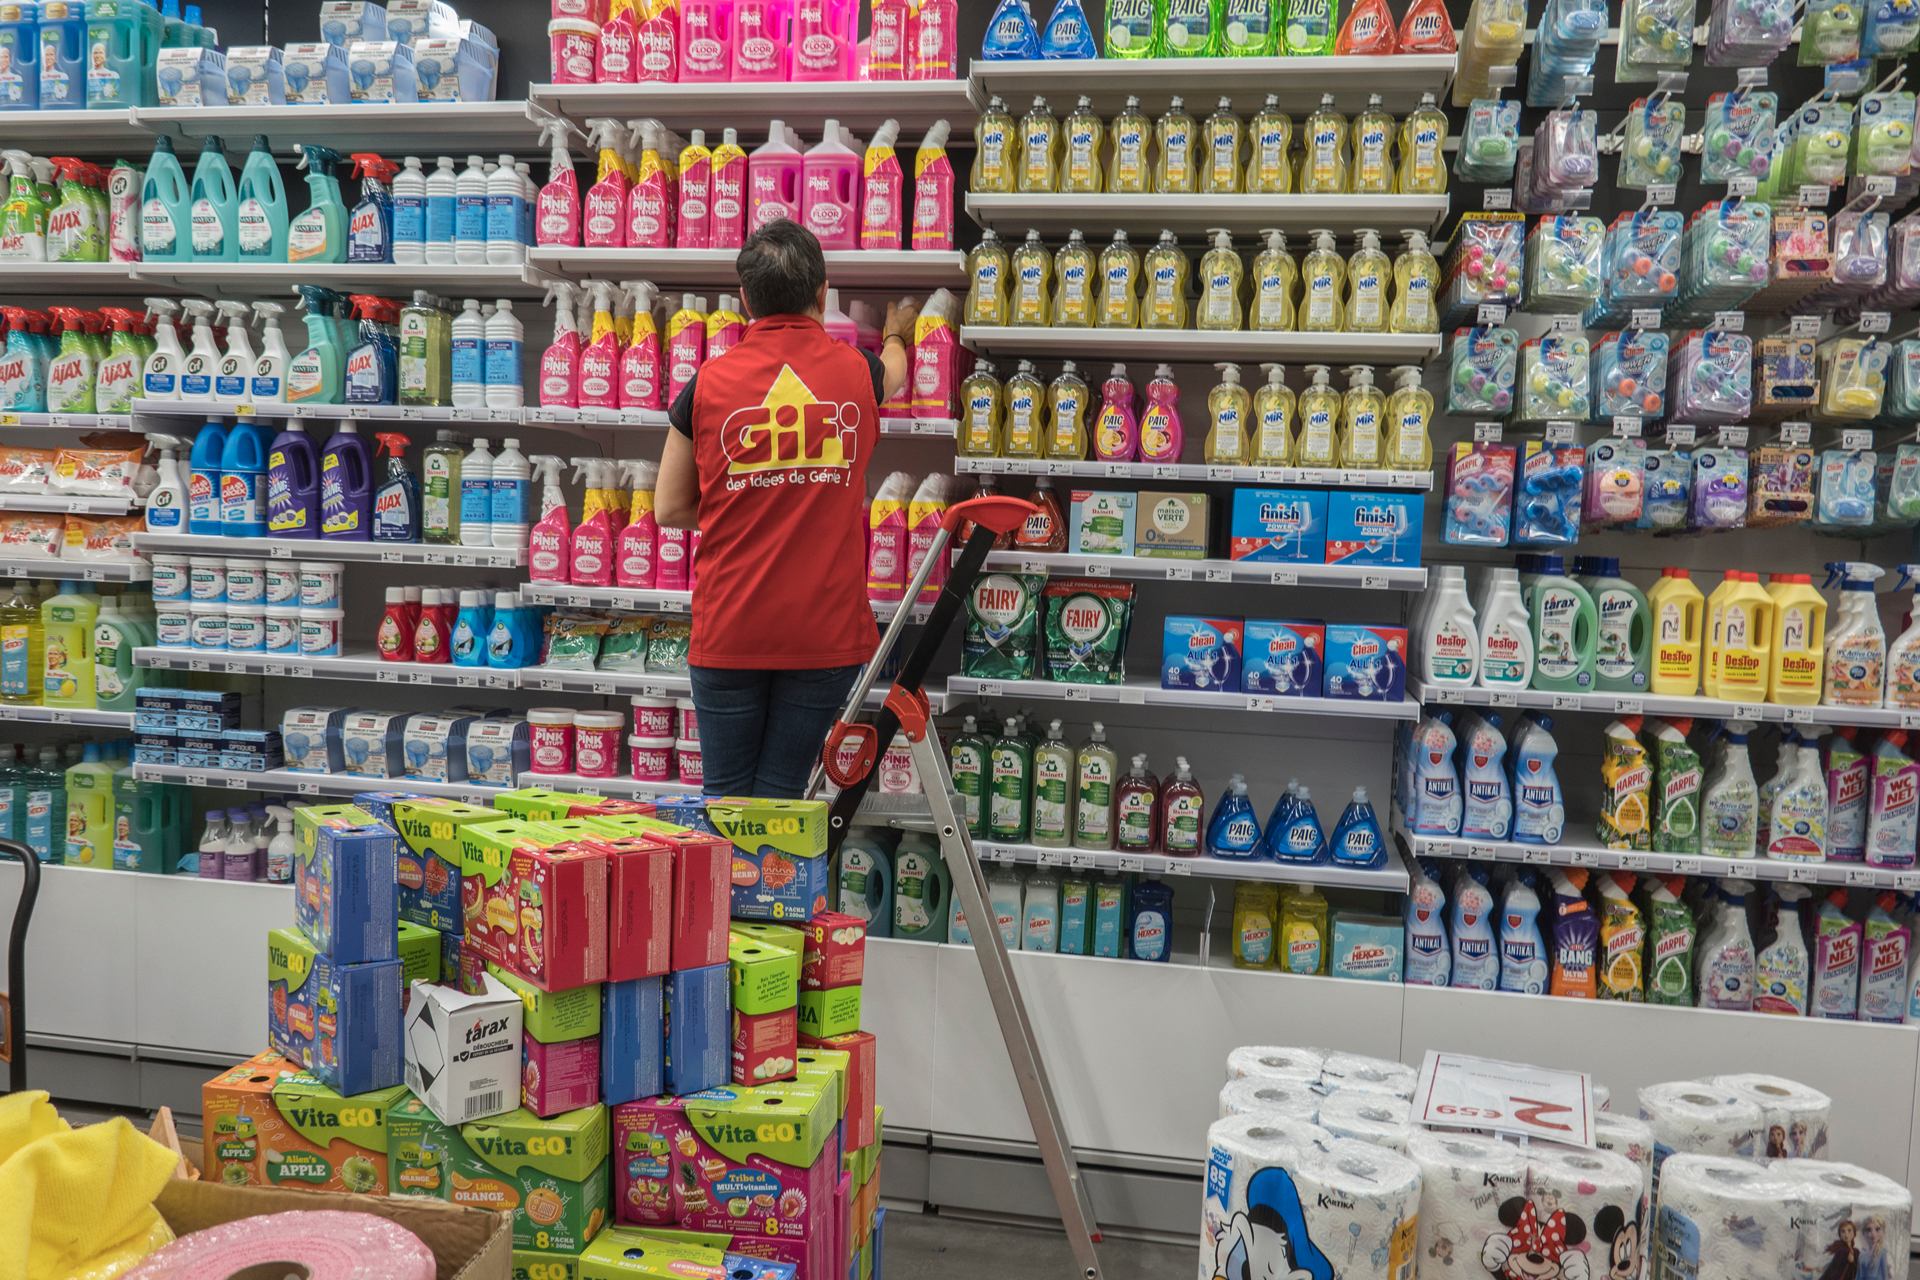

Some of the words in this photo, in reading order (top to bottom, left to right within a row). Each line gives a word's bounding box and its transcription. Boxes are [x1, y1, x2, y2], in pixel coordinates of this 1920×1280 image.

[998, 20, 1023, 35] PAIC
[1055, 21, 1080, 35] PAIC
[1354, 15, 1379, 31] PAIC
[1414, 15, 1442, 30] PAIC
[805, 42, 831, 50] FLOOR
[715, 182, 740, 193] PINK
[541, 200, 570, 210] PINK
[812, 210, 839, 218] FLOOR
[50, 211, 81, 232] AJAX
[351, 213, 374, 233] AJAX
[673, 347, 697, 358] PINK
[152, 358, 167, 373] Cif
[187, 358, 204, 374] Cif
[223, 358, 238, 374] Cif
[257, 361, 272, 377] Cif
[348, 354, 371, 375] AJAX
[544, 361, 569, 371] PINK
[583, 362, 610, 373] PINK
[626, 364, 653, 373] PINK
[52, 360, 83, 384] AJAX
[101, 360, 133, 384] AJAX
[1103, 415, 1124, 427] PAIC
[1148, 415, 1168, 427] PAIC
[1456, 458, 1480, 474] HARPIC
[1526, 456, 1548, 471] HARPIC
[726, 477, 746, 491] des
[750, 471, 785, 489] idées
[789, 470, 805, 484] de
[809, 468, 841, 484] Génie
[845, 470, 851, 487] !
[156, 493, 173, 507] Cif
[376, 493, 401, 513] AJAX
[1158, 514, 1184, 522] VERTE
[1260, 504, 1300, 520] finish
[1356, 507, 1395, 523] finish
[1026, 516, 1050, 530] PAIC
[1361, 526, 1388, 534] POWER
[661, 527, 683, 536] PINK
[533, 536, 559, 547] PINK
[576, 540, 603, 550] PINK
[624, 541, 651, 551] PINK
[873, 535, 896, 546] PINK
[911, 536, 933, 546] PINK
[979, 588, 1020, 611] FAIRY
[1543, 596, 1576, 612] tarax
[1601, 599, 1633, 613] tarax
[1066, 608, 1101, 628] FAIRY
[1190, 635, 1215, 647] Clean
[1269, 640, 1295, 653] Clean
[1436, 634, 1466, 649] DesTop
[1487, 636, 1518, 651] DesTop
[1352, 643, 1378, 656] Clean
[1660, 650, 1692, 664] DesTop
[1726, 655, 1759, 669] DesTop
[1783, 657, 1816, 670] DesTop
[1248, 672, 1260, 680] 40
[1330, 675, 1342, 684] 40
[641, 715, 669, 726] PINK
[535, 732, 564, 742] PINK
[577, 734, 603, 746] PINK
[638, 757, 666, 767] PINK
[884, 755, 910, 766] PINK
[995, 767, 1020, 776] Rainett
[1040, 770, 1064, 780] Rainett
[1083, 773, 1108, 783] Rainett
[1843, 769, 1863, 784] WC
[1427, 781, 1452, 792] ANTIKAL
[1616, 772, 1646, 793] HARPIC
[1667, 775, 1696, 796] HARPIC
[1890, 776, 1911, 791] WC
[1472, 783, 1499, 797] ANTIKAL
[1525, 789, 1552, 801] ANTIKAL
[1839, 782, 1864, 798] NET
[1886, 787, 1913, 805] NET
[723, 817, 805, 836] VitaGO!
[1228, 822, 1254, 837] PAIC
[1290, 828, 1317, 842] PAIC
[1348, 832, 1374, 847] PAIC
[773, 902, 784, 919] 8
[431, 910, 438, 928] 8
[816, 927, 824, 943] 8
[1137, 928, 1162, 939] HEROES
[1244, 930, 1269, 943] HEROES
[1292, 942, 1318, 953] HEROES
[1414, 936, 1441, 949] ANTIKAL
[1461, 940, 1488, 954] ANTIKAL
[1609, 931, 1637, 951] HARPIC
[1657, 935, 1688, 957] HARPIC
[1832, 937, 1853, 953] WC
[1352, 949, 1384, 961] HEROES
[1507, 944, 1533, 957] ANTIKAL
[1879, 942, 1900, 956] WC
[1560, 949, 1592, 966] BANG
[1829, 949, 1855, 965] NET
[1875, 951, 1902, 967] NET
[1563, 970, 1588, 980] ULTRA
[466, 1017, 509, 1044] tarax
[290, 1108, 383, 1128] VitaGO!
[706, 1123, 802, 1144] VitaGO!
[222, 1149, 250, 1157] APPLE
[476, 1136, 573, 1157] VitaGO!
[286, 1155, 317, 1163] Alien's
[279, 1165, 326, 1177] APPLE
[729, 1174, 754, 1182] Tribe
[756, 1174, 766, 1182] of
[1210, 1165, 1226, 1189] 85
[476, 1183, 498, 1191] Little
[716, 1183, 778, 1192] MULTIvitamins
[1209, 1183, 1225, 1197] YEARS
[455, 1192, 504, 1201] ORANGE
[765, 1217, 779, 1236] 8
[536, 1231, 549, 1249] 8
[551, 1236, 574, 1244] PACKS
